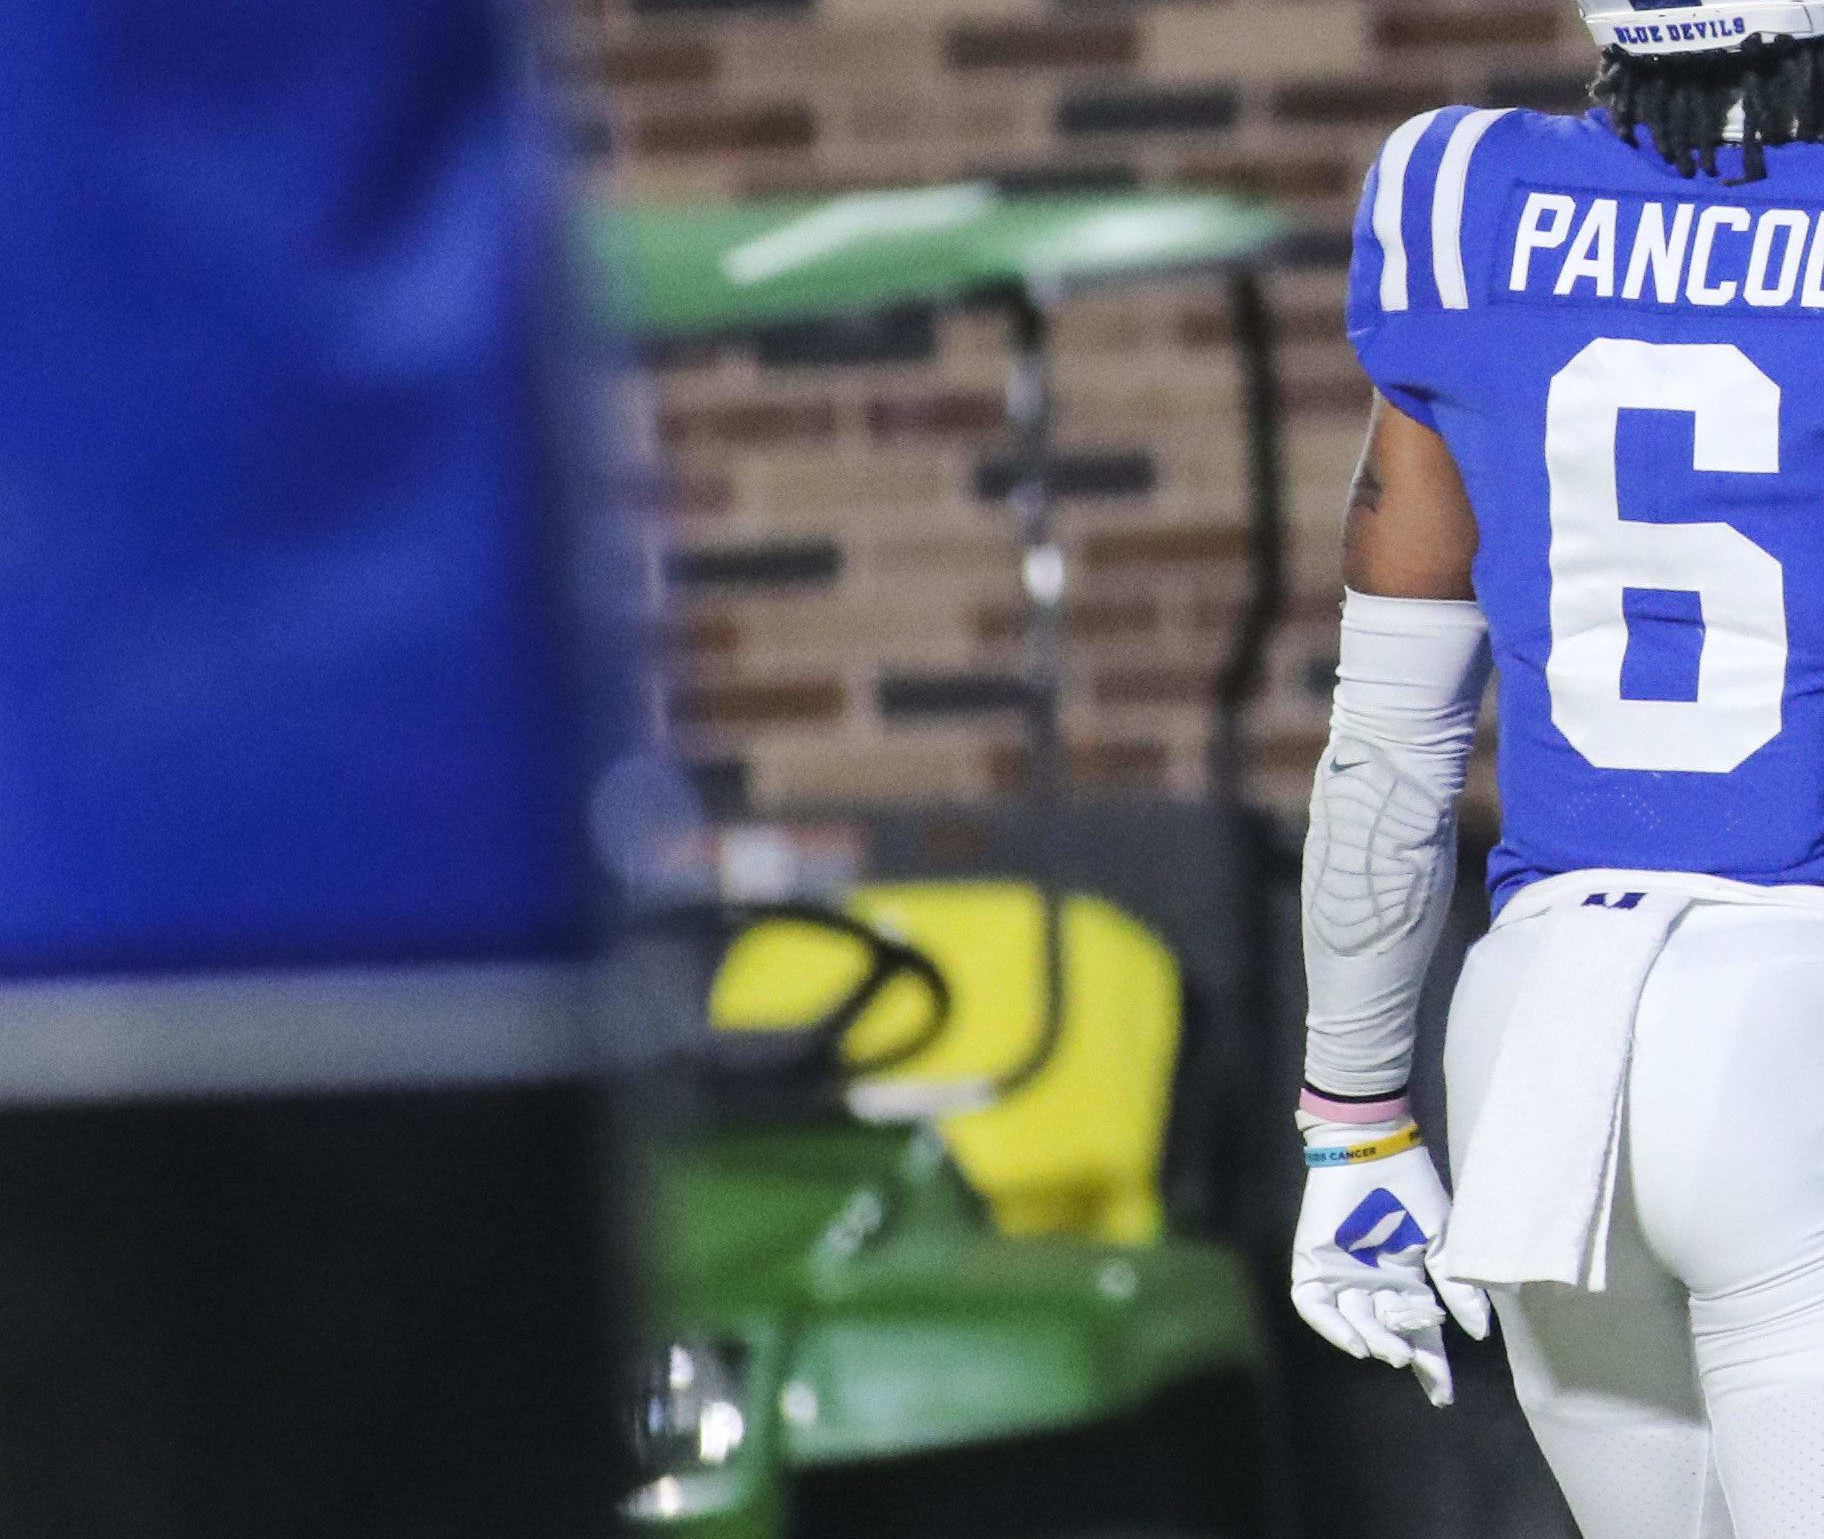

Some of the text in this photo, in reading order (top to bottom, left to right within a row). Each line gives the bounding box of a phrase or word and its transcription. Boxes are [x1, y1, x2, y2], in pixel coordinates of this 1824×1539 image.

[1614, 16, 1745, 45] BLUE DEVILS
[1545, 337, 1788, 773] 6
[1330, 1146, 1377, 1161] CANCER
